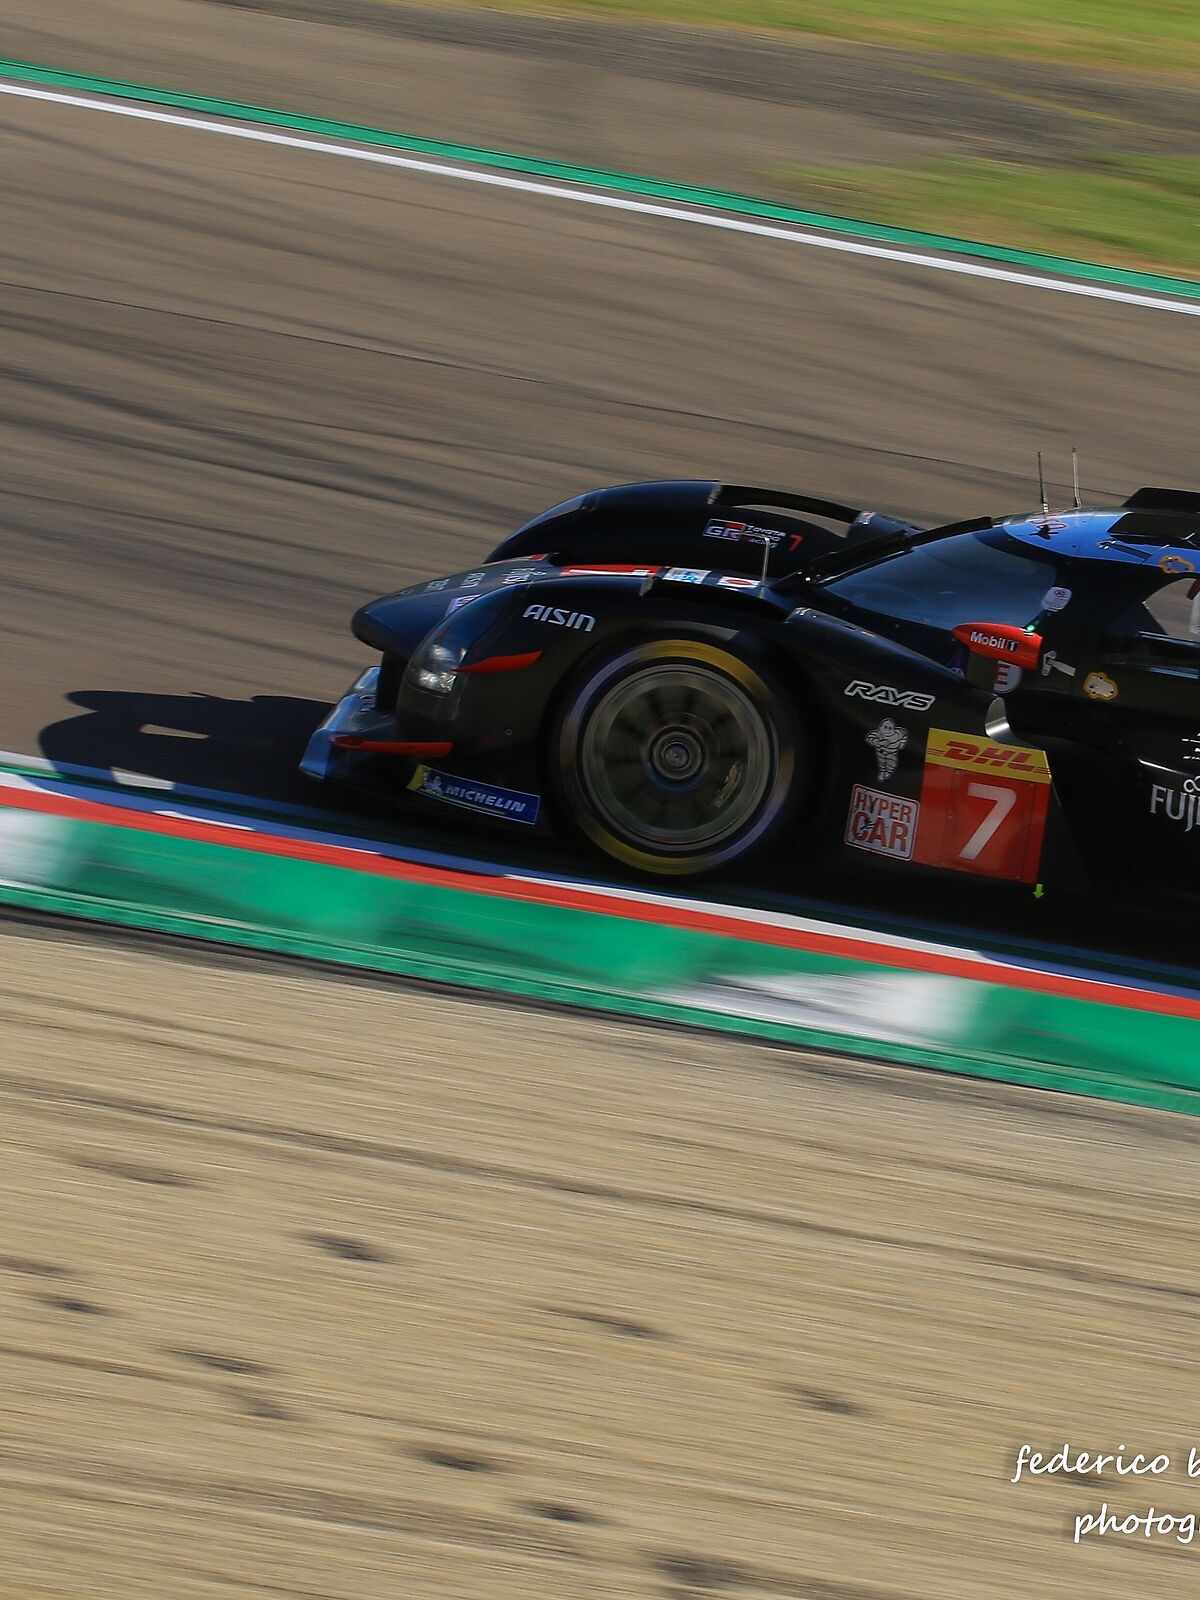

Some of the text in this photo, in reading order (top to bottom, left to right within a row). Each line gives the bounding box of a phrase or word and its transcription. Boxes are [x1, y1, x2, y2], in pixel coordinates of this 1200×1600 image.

[789, 533, 805, 552] 7
[522, 603, 598, 633] AISIN
[970, 631, 1006, 650] Mobil
[844, 679, 937, 712] RAYS
[945, 741, 1035, 771] DHL
[446, 784, 527, 813] MICHELIN
[854, 792, 911, 823] HYPER
[852, 811, 909, 852] CAR
[958, 782, 1017, 860] 7
